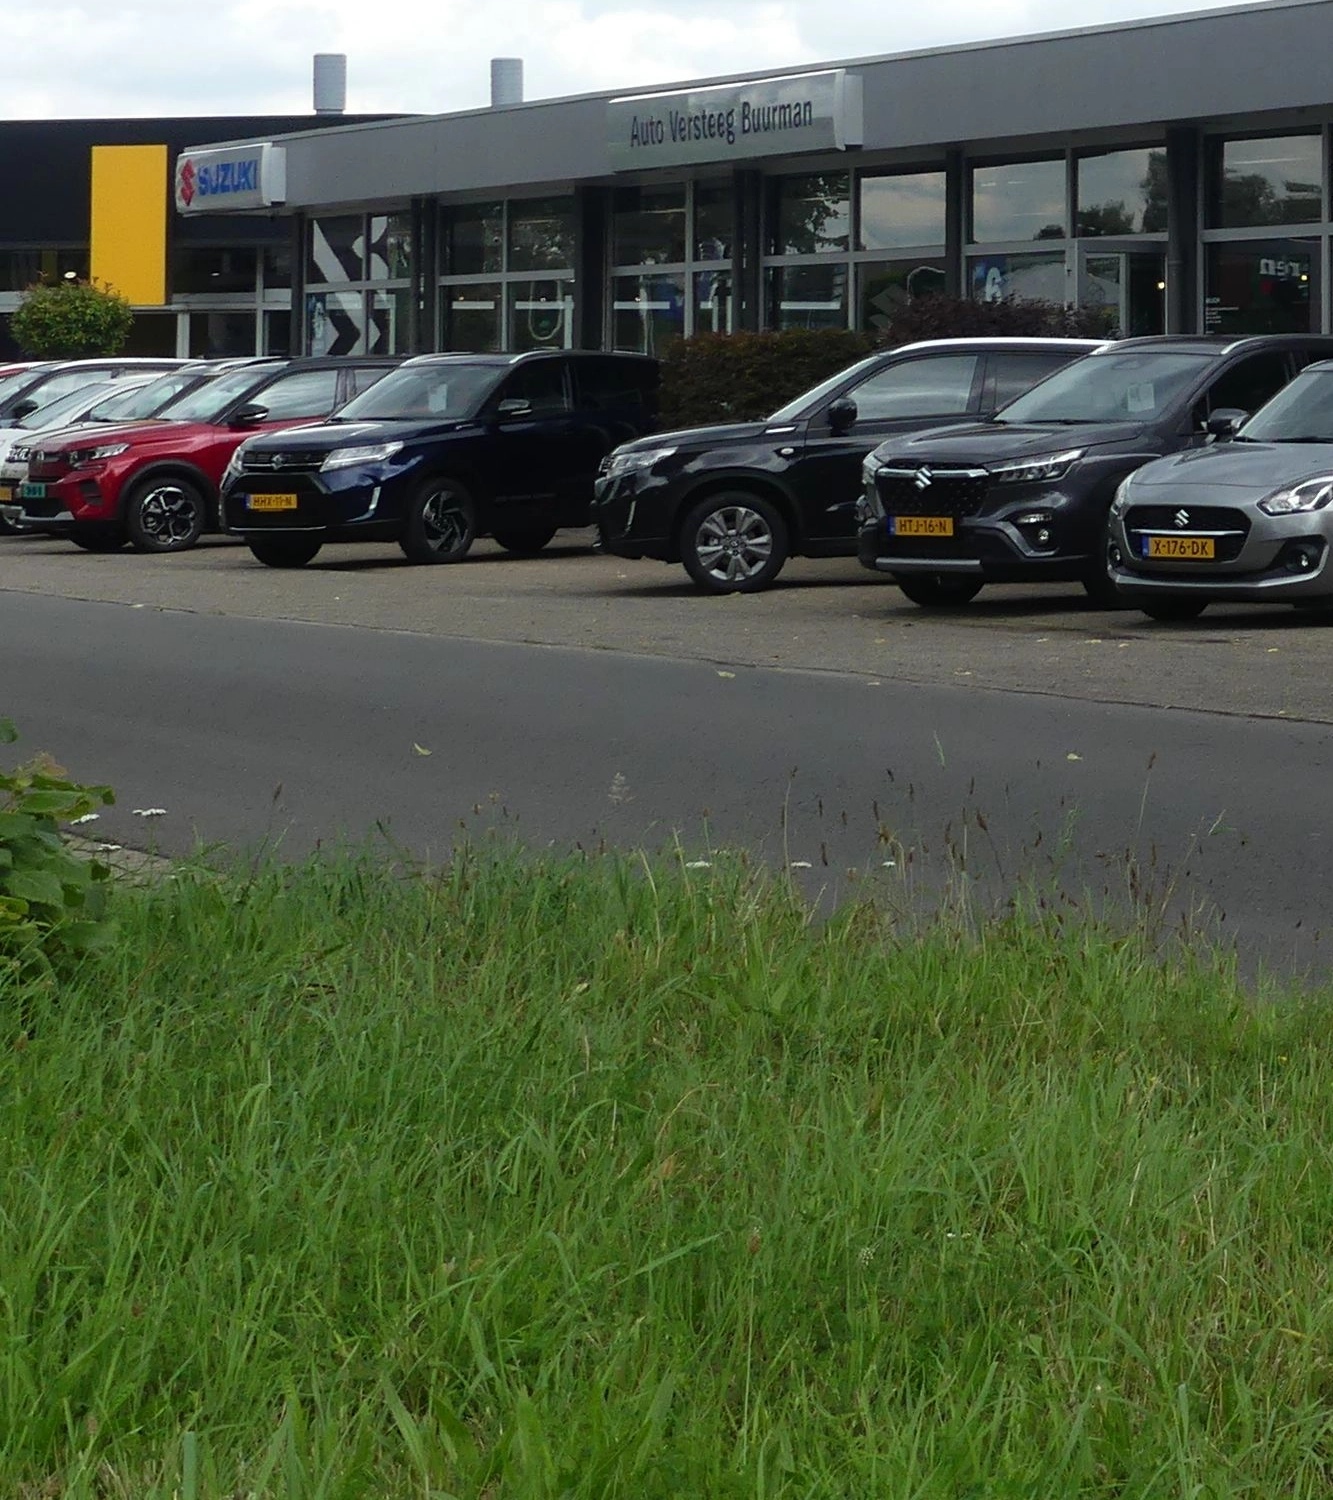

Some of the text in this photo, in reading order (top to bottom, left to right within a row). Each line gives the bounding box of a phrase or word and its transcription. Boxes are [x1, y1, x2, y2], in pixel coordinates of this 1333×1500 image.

[630, 100, 813, 147] Auto Versteeg Buurman
[198, 159, 258, 196] SUZUKI
[899, 519, 947, 533] HTJ-16-N
[1154, 540, 1209, 556] X-176-DK
